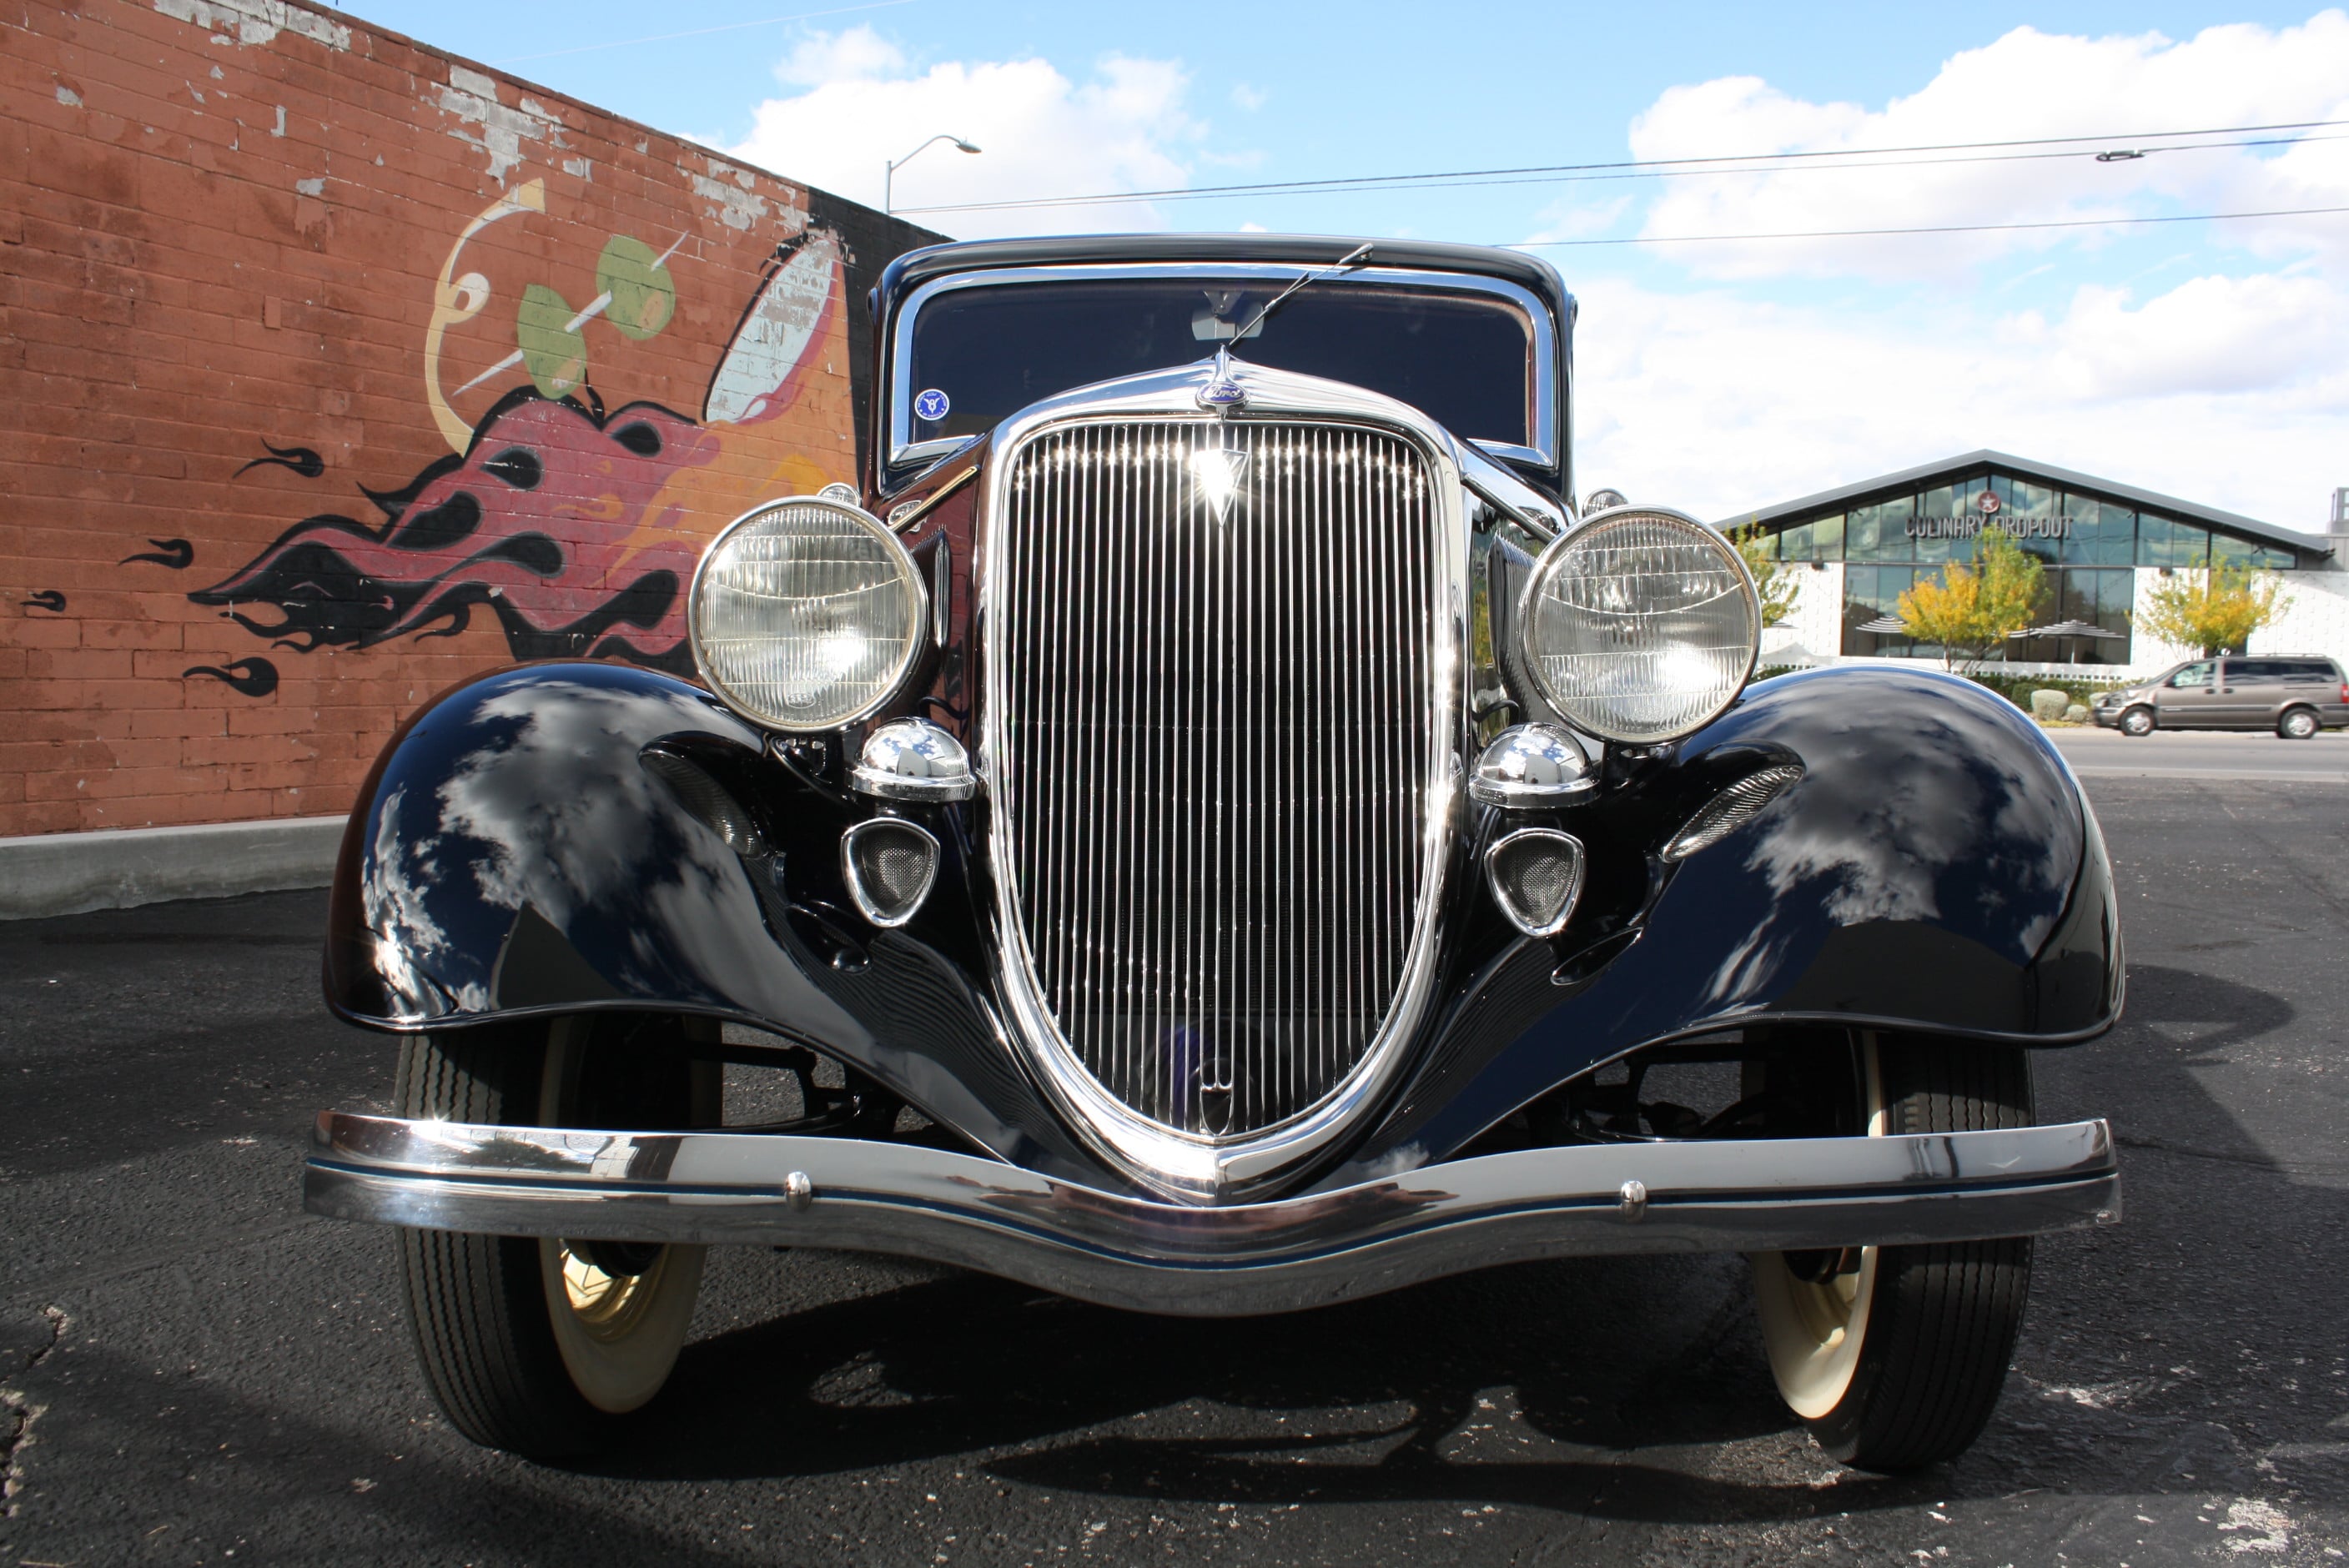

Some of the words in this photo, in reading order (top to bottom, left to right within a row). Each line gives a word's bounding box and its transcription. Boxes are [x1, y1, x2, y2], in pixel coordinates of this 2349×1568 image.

[1201, 384, 1241, 399] Ford
[1904, 515, 1987, 538] CULINARY
[1994, 515, 2073, 538] DROPOUT
